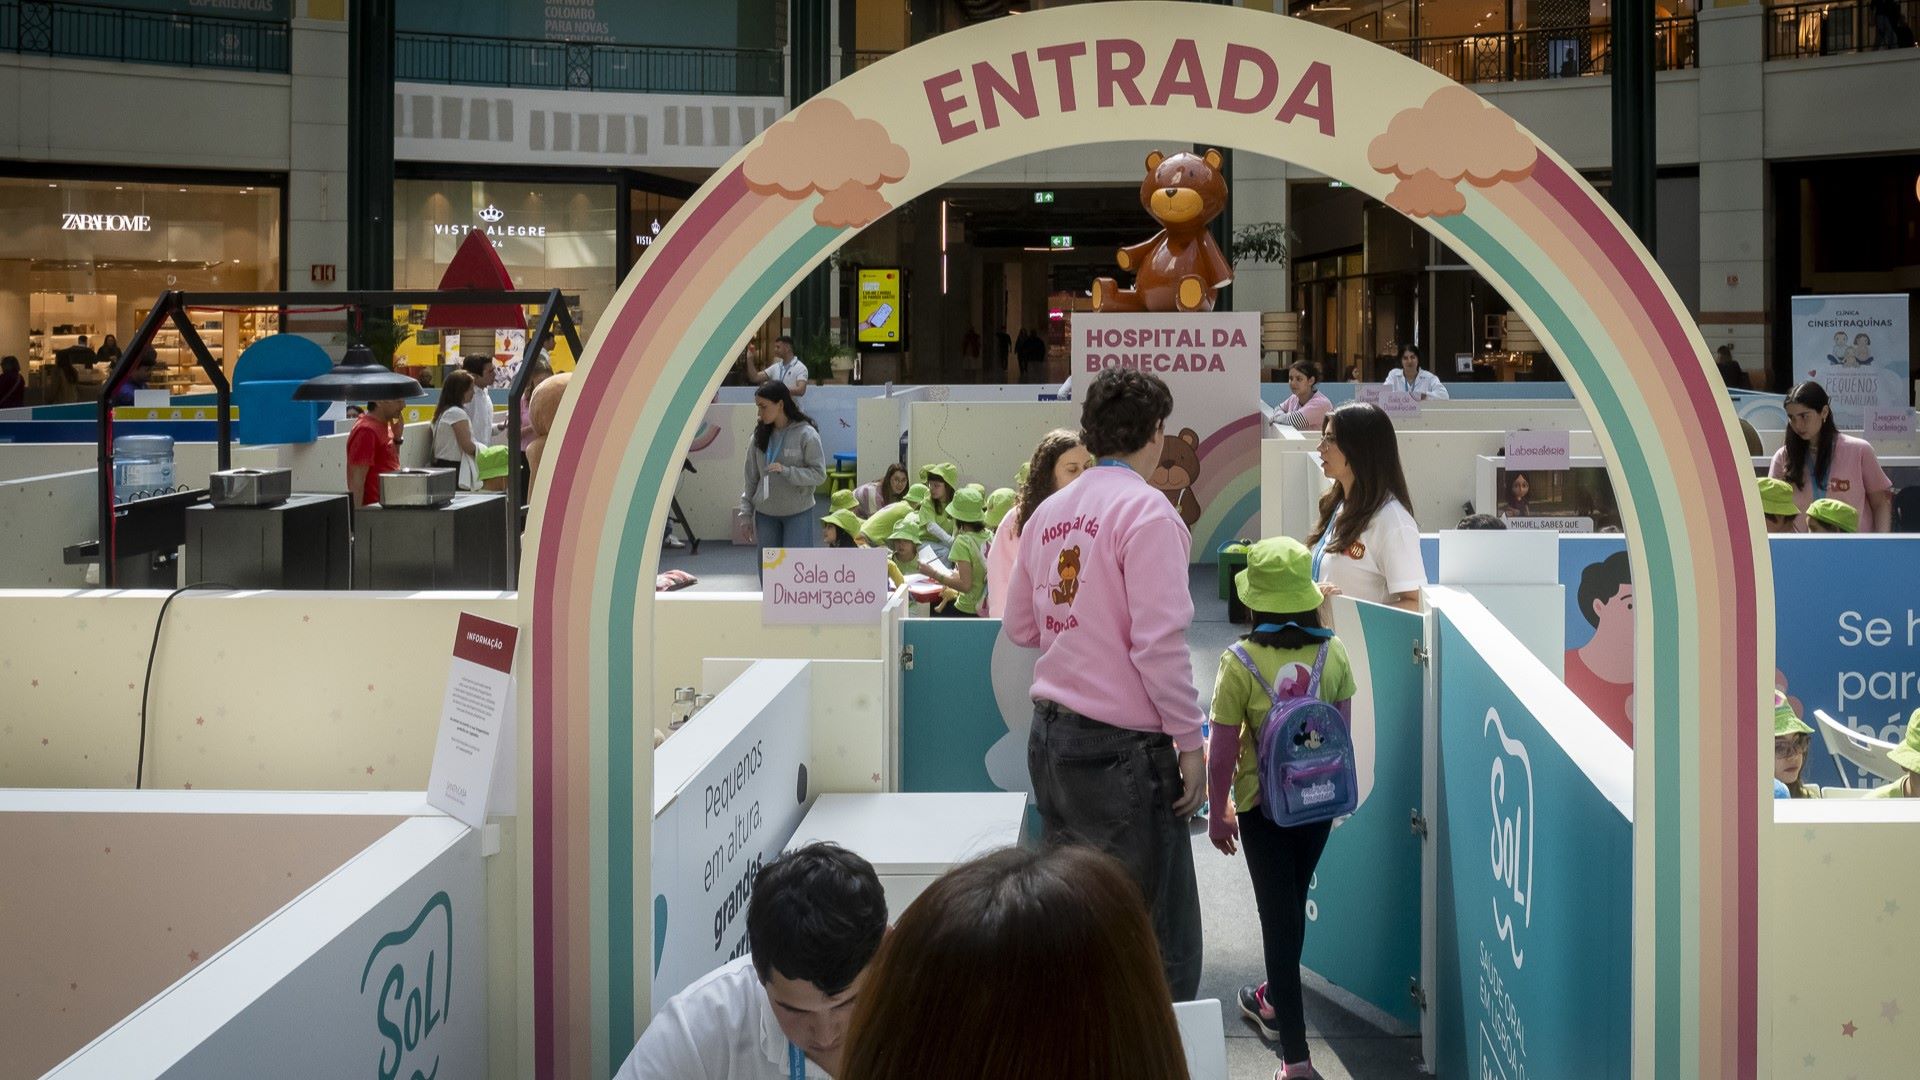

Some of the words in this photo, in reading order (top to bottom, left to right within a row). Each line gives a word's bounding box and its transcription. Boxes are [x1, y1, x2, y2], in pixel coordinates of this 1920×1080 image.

[545, 6, 596, 20] COLOMBO
[545, 20, 573, 33] PARA
[575, 22, 609, 34] NOVAS
[923, 38, 1336, 145] ENTRADA
[486, 225, 546, 237] ALEGRE
[1086, 328, 1206, 348] HOSPITAL
[1212, 328, 1247, 348] DA
[1086, 353, 1226, 373] BONECADA
[1084, 517, 1100, 539] da
[1540, 520, 1564, 529] SABES
[793, 561, 829, 584] Sala
[833, 564, 856, 584] da
[1838, 610, 1892, 647] Se
[466, 631, 503, 650] INFORMAÇÃO
[1838, 671, 1920, 713] par
[705, 739, 763, 829] Pequenos
[704, 843, 724, 893] em
[727, 799, 762, 864] altura,
[714, 850, 763, 952] grandes
[1479, 940, 1504, 1008] SAÚDE
[1504, 992, 1527, 1057] ORAL
[1480, 974, 1491, 1017] EM
